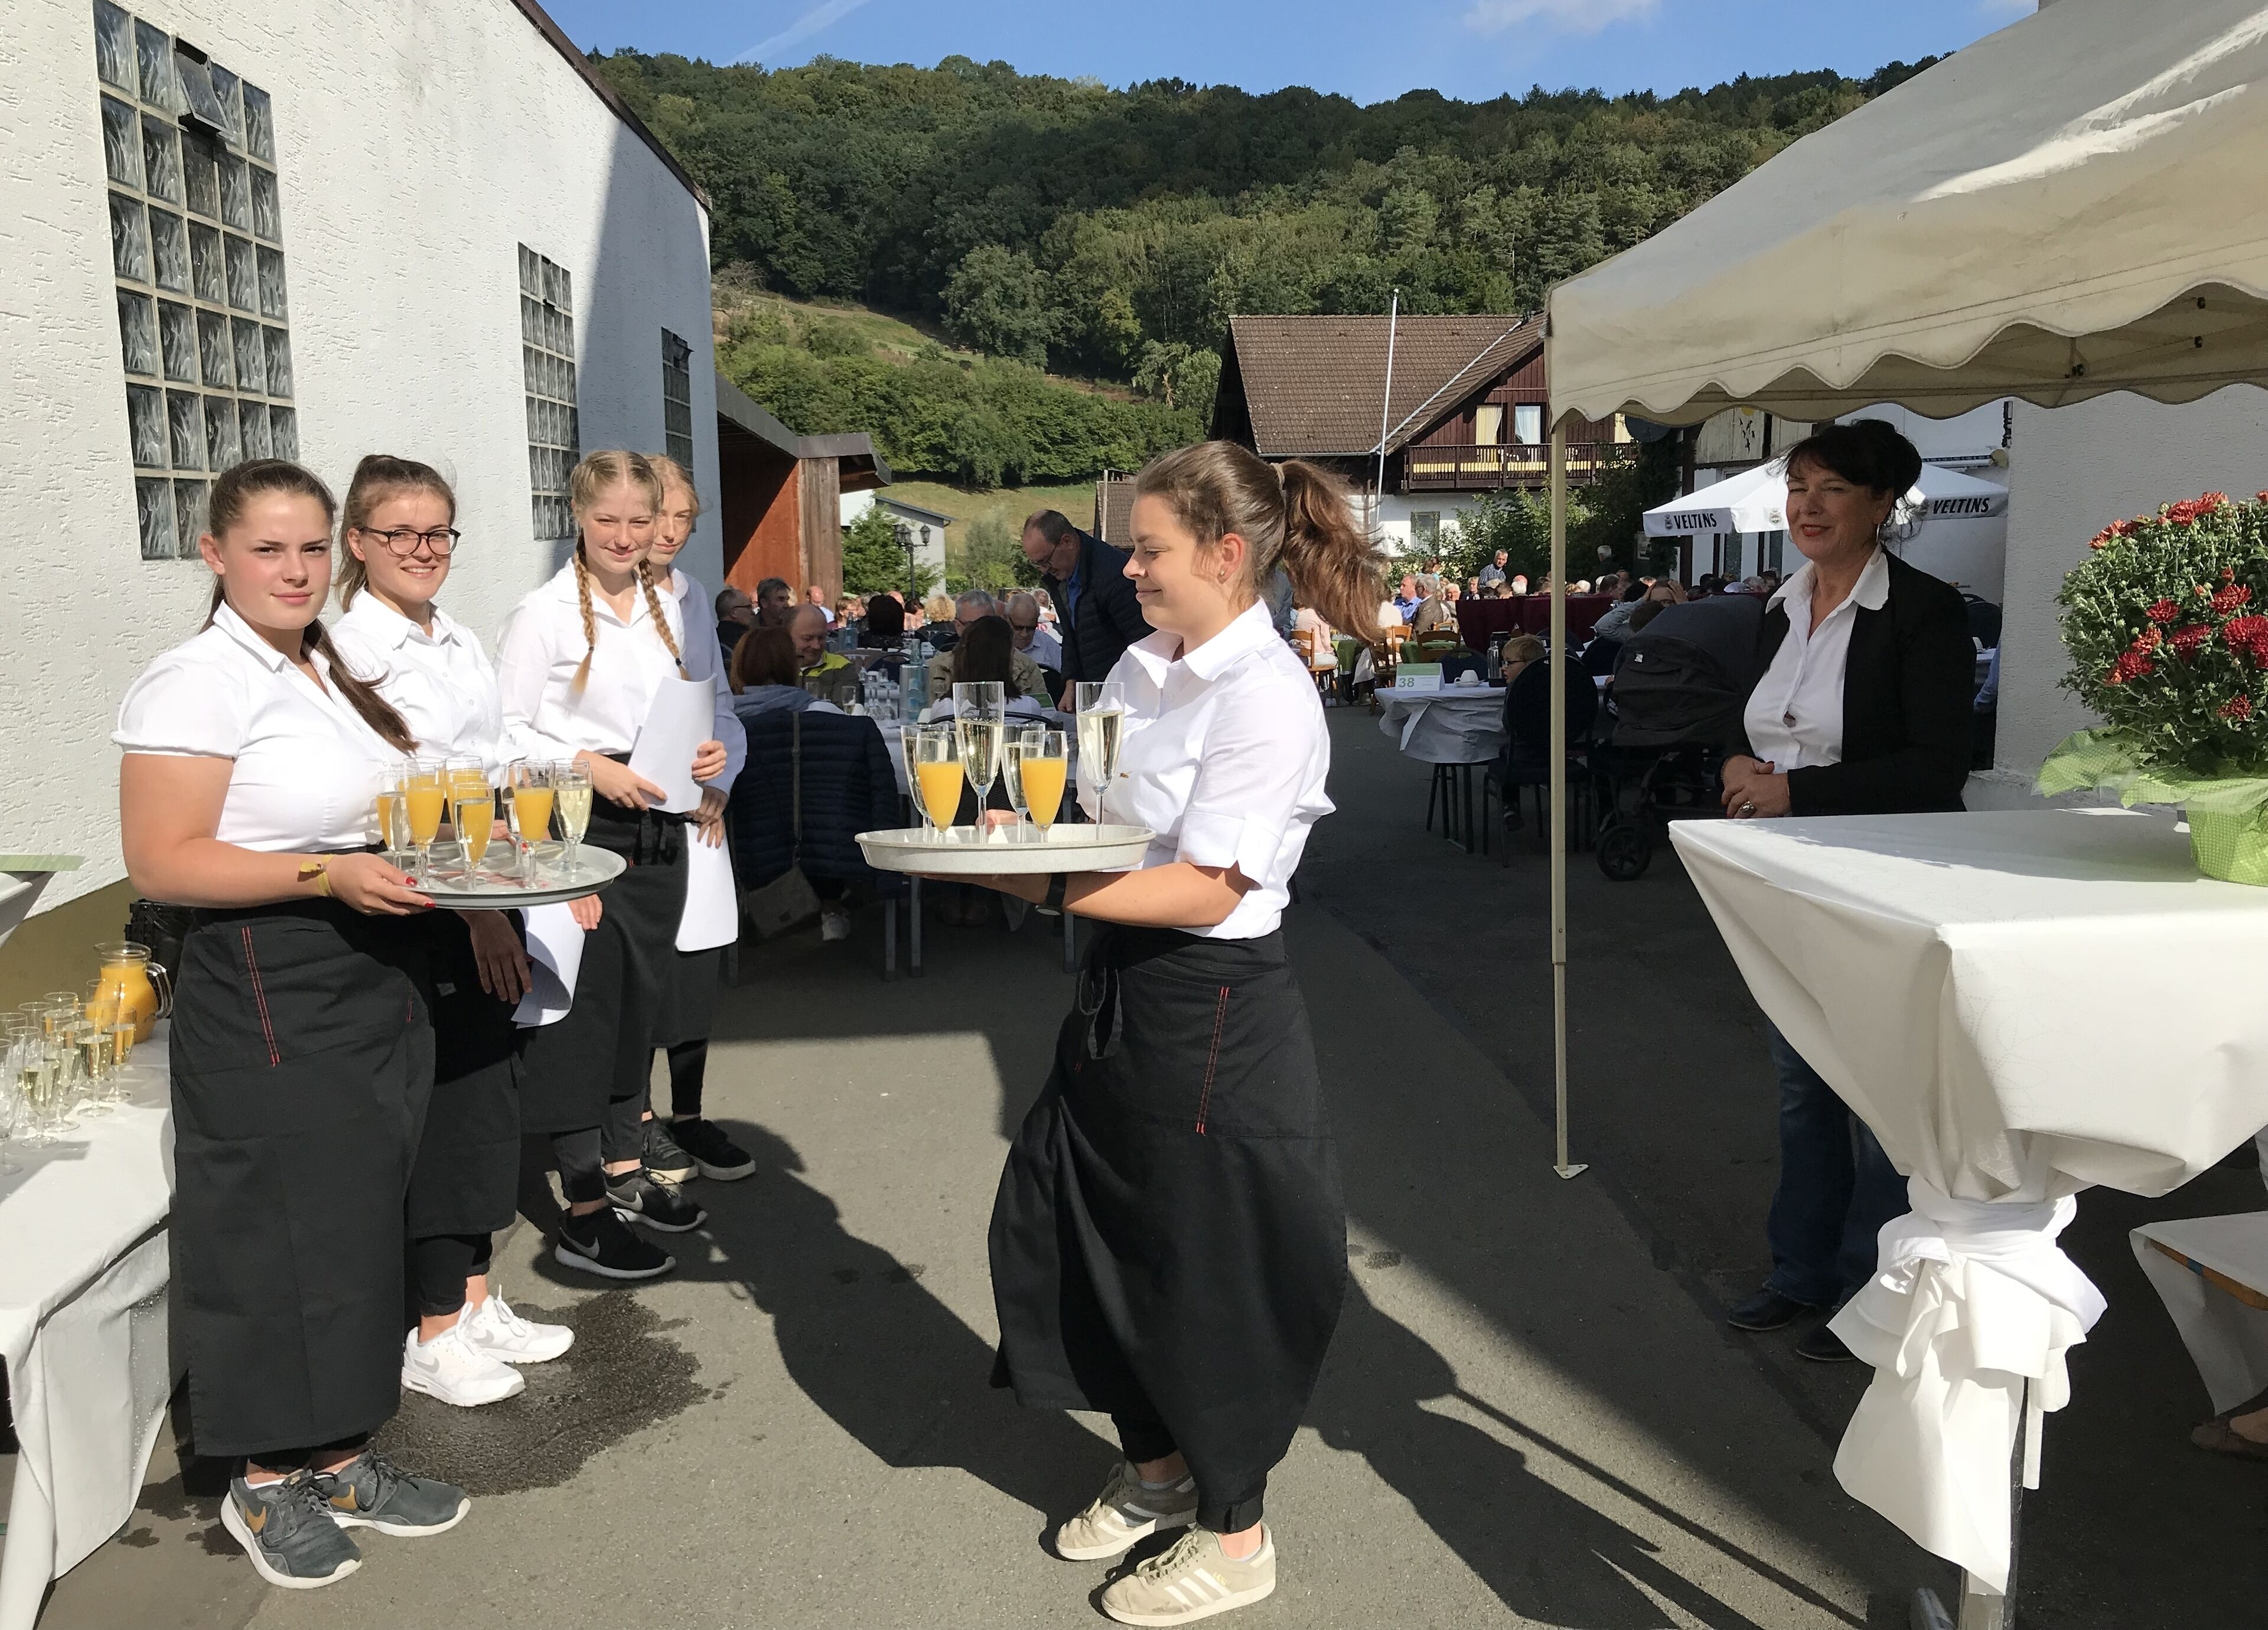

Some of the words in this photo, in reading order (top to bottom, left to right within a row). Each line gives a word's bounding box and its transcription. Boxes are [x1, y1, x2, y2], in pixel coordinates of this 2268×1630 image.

[1933, 497, 1990, 514] VELTINS
[1674, 513, 1717, 529] VELTINS
[1399, 677, 1415, 687] 38
